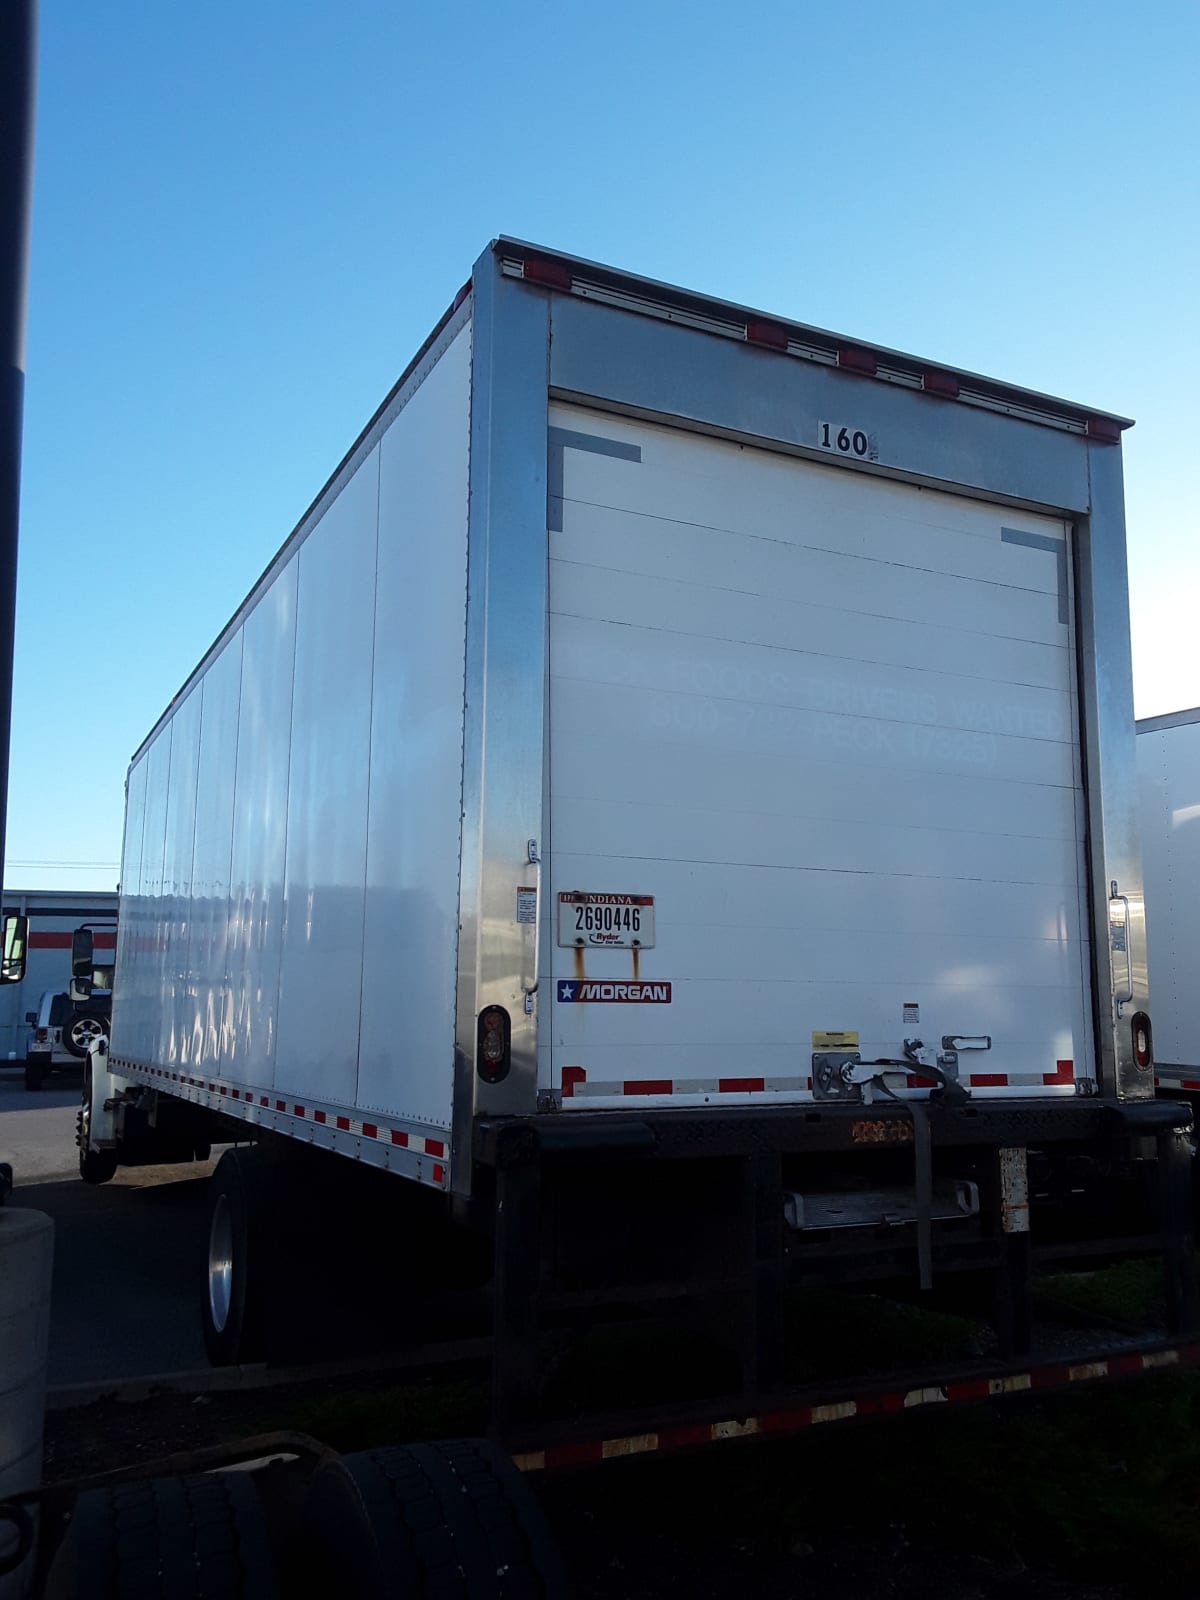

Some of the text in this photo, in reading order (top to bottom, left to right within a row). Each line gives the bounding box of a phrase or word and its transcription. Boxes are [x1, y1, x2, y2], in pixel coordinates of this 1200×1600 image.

[822, 424, 867, 456] 160
[948, 695, 1064, 738] WANTED
[585, 895, 633, 905] INDIANA
[575, 906, 640, 931] 2690446
[596, 932, 621, 941] Ryder
[580, 984, 667, 1000] MORGAN
